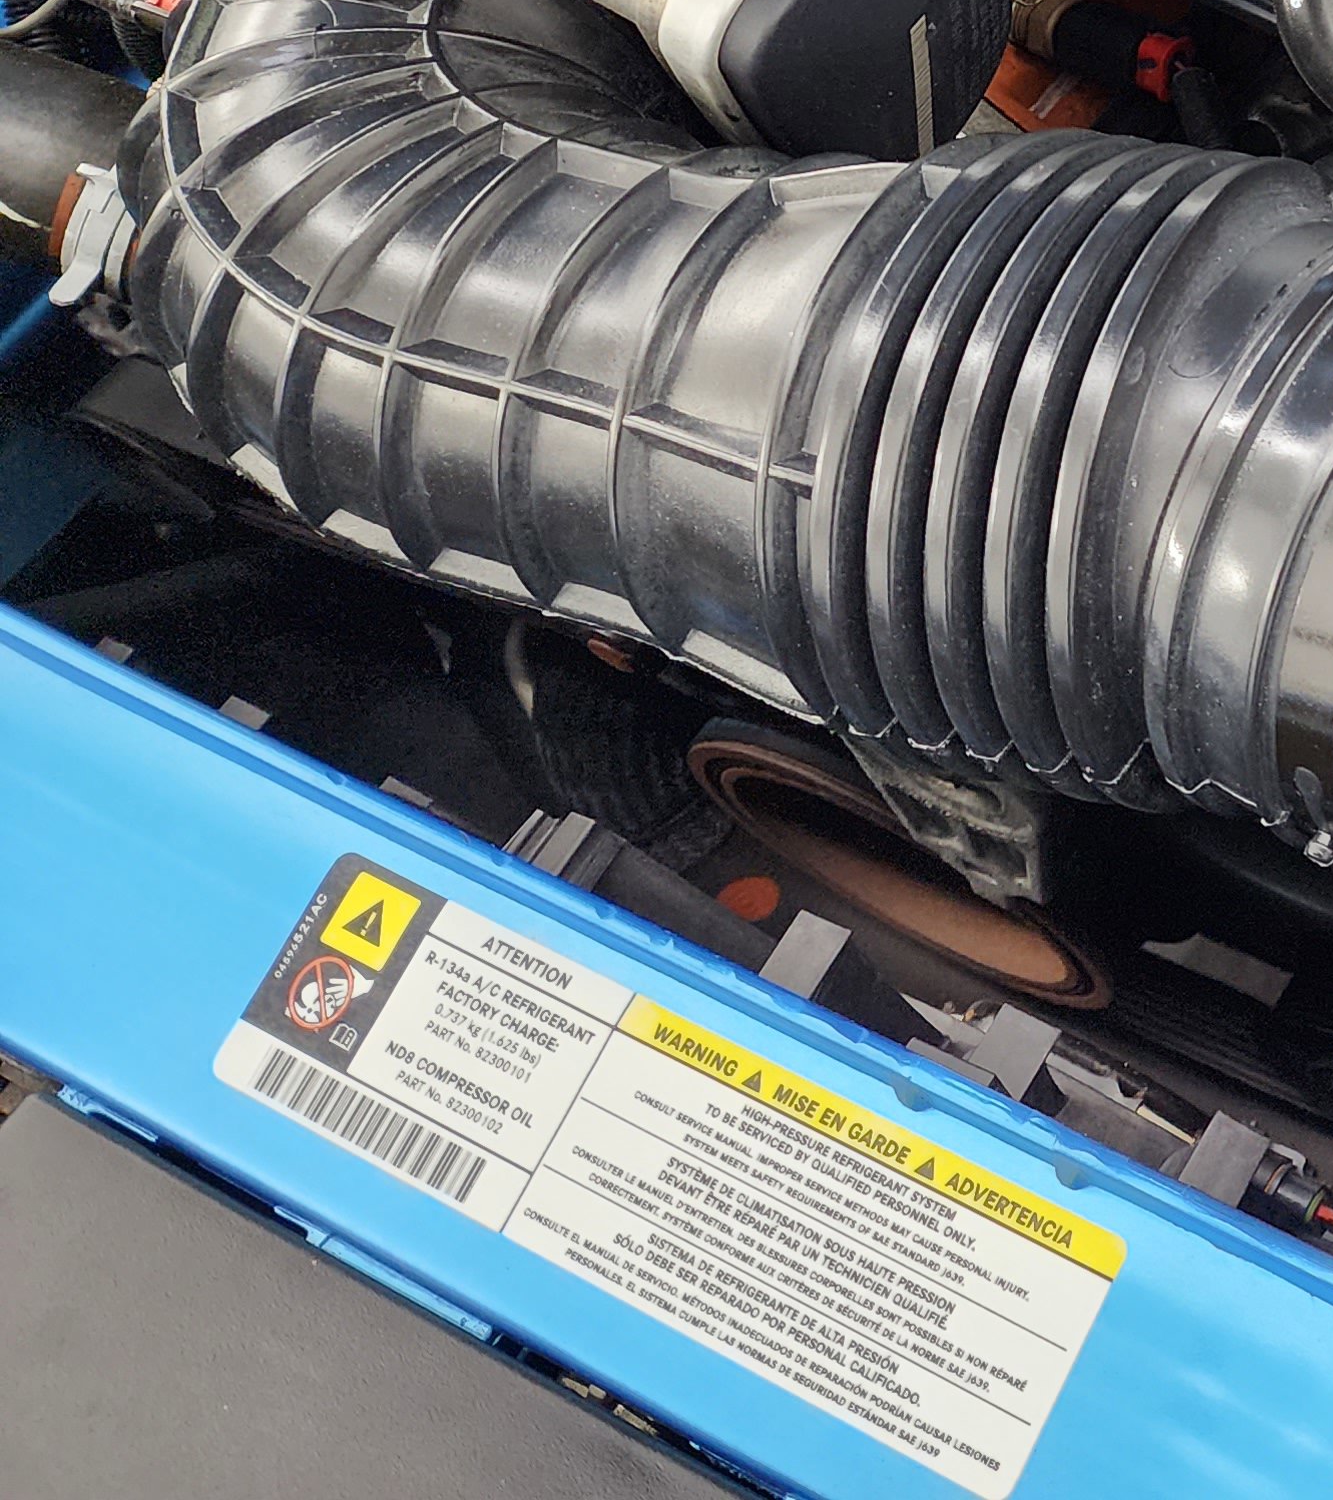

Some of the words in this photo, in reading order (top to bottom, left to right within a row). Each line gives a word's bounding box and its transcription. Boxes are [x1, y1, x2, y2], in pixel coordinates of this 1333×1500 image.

[423, 949, 471, 983] R-134a
[470, 974, 502, 998] A/C
[500, 988, 596, 1045] REFRIGERANT
[435, 979, 501, 1020] FACTORY
[498, 1012, 560, 1053] CHARGE:
[479, 935, 573, 990] ATTENTION
[383, 1039, 416, 1065] ND8
[415, 1056, 510, 1115] COMPRESSOR
[509, 1105, 533, 1129] OIL
[423, 1018, 456, 1043] PART
[453, 1034, 471, 1054] No.
[473, 1045, 532, 1083] 82300101
[433, 1001, 468, 1026] 0.737
[465, 1018, 483, 1039] kg
[479, 1026, 520, 1055] (1.625
[517, 1045, 542, 1069] lbs)
[652, 1022, 739, 1077] WARNING
[394, 1068, 427, 1092] PART
[423, 1084, 442, 1105] No.
[444, 1095, 504, 1135] 82300102
[739, 1103, 831, 1158] HIGH-PRESSURE
[830, 1149, 911, 1197] REFRIGERANT
[909, 1189, 958, 1222] SYSTEM
[771, 1082, 820, 1119] MISE
[817, 1106, 848, 1133] EN
[846, 1121, 912, 1165] GARDE
[633, 1089, 676, 1116] CONSULT
[674, 1110, 714, 1137] SERVICE
[755, 1152, 804, 1183] IMPROPER
[802, 1176, 844, 1204] SERVICE
[842, 1196, 890, 1228] METHODS
[889, 1220, 912, 1238] MAY
[910, 1232, 944, 1256] CAUSE
[942, 1248, 992, 1282] PERSONAL
[656, 1168, 704, 1200] DEVANT
[702, 1189, 733, 1216] ÊTRE
[731, 1207, 779, 1239] RÉPARÉ
[775, 1230, 801, 1252] PAR
[800, 1243, 821, 1262] UN
[820, 1253, 892, 1300] TECHNICIEN
[665, 1155, 719, 1191] SYSTÈME
[717, 1181, 736, 1200] DE
[735, 1191, 823, 1245] CLIMATISATION
[821, 1236, 857, 1262] SOUS
[855, 1253, 897, 1284] HAUTE
[895, 1275, 957, 1315] PRESSION
[681, 1132, 719, 1157] SYSTEM
[718, 1151, 750, 1174] MEETS
[749, 1167, 785, 1191] SAFETY
[784, 1185, 857, 1229] REQUIREMENTS
[870, 1229, 891, 1247] SAE
[889, 1239, 941, 1273] STANDARD
[704, 1101, 722, 1119] TO
[720, 1110, 739, 1128] BE
[736, 1119, 794, 1155] SERVICED
[792, 1147, 812, 1164] BY
[810, 1157, 872, 1196] QUALIFIED
[871, 1188, 940, 1233] PERSONNEL
[942, 1224, 977, 1252] ONLY.
[944, 1172, 1073, 1249] ADVERTENCIA
[571, 1144, 624, 1179] CONSULTER
[635, 1178, 674, 1206] MANUEL
[735, 1231, 757, 1248] DES
[754, 1241, 809, 1276] BLESSURES
[808, 1269, 876, 1311] CORPORELLES
[874, 1304, 903, 1325] SONT
[901, 1318, 954, 1353] POSSIBLES
[964, 1352, 989, 1372] NON
[611, 1231, 645, 1256] SÓLO
[643, 1248, 676, 1274] DEBE
[674, 1265, 699, 1287] SER
[698, 1278, 761, 1319] REPARADO
[759, 1310, 787, 1334] POR
[785, 1325, 847, 1368] PERSONAL
[848, 1359, 921, 1407] CALIFICADO.
[646, 1231, 696, 1267] SISTEMA
[696, 1258, 715, 1277] DE
[713, 1267, 800, 1322] REFRIGERANTE
[798, 1312, 818, 1332] DE
[816, 1323, 846, 1347] ALTA
[845, 1338, 900, 1375] PRESIÓN
[702, 1232, 756, 1267] CONFORME
[754, 1260, 777, 1278] AUX
[908, 1341, 947, 1369] NORME
[945, 1361, 967, 1379] SAE
[522, 1206, 571, 1238] CONSULTE
[581, 1238, 620, 1267] MANUAL
[725, 1316, 795, 1359] INADECUADOS
[912, 1417, 953, 1446] CAUSAR
[951, 1437, 1001, 1472] LESIONES
[636, 1286, 677, 1315] SISTEMA
[677, 1308, 718, 1337] CUMPLE
[715, 1329, 737, 1347] LAS
[735, 1340, 778, 1370] NORMAS
[790, 1370, 847, 1407] SEGURIDAD
[896, 1427, 918, 1446] SAE
[914, 1439, 941, 1458] J639
